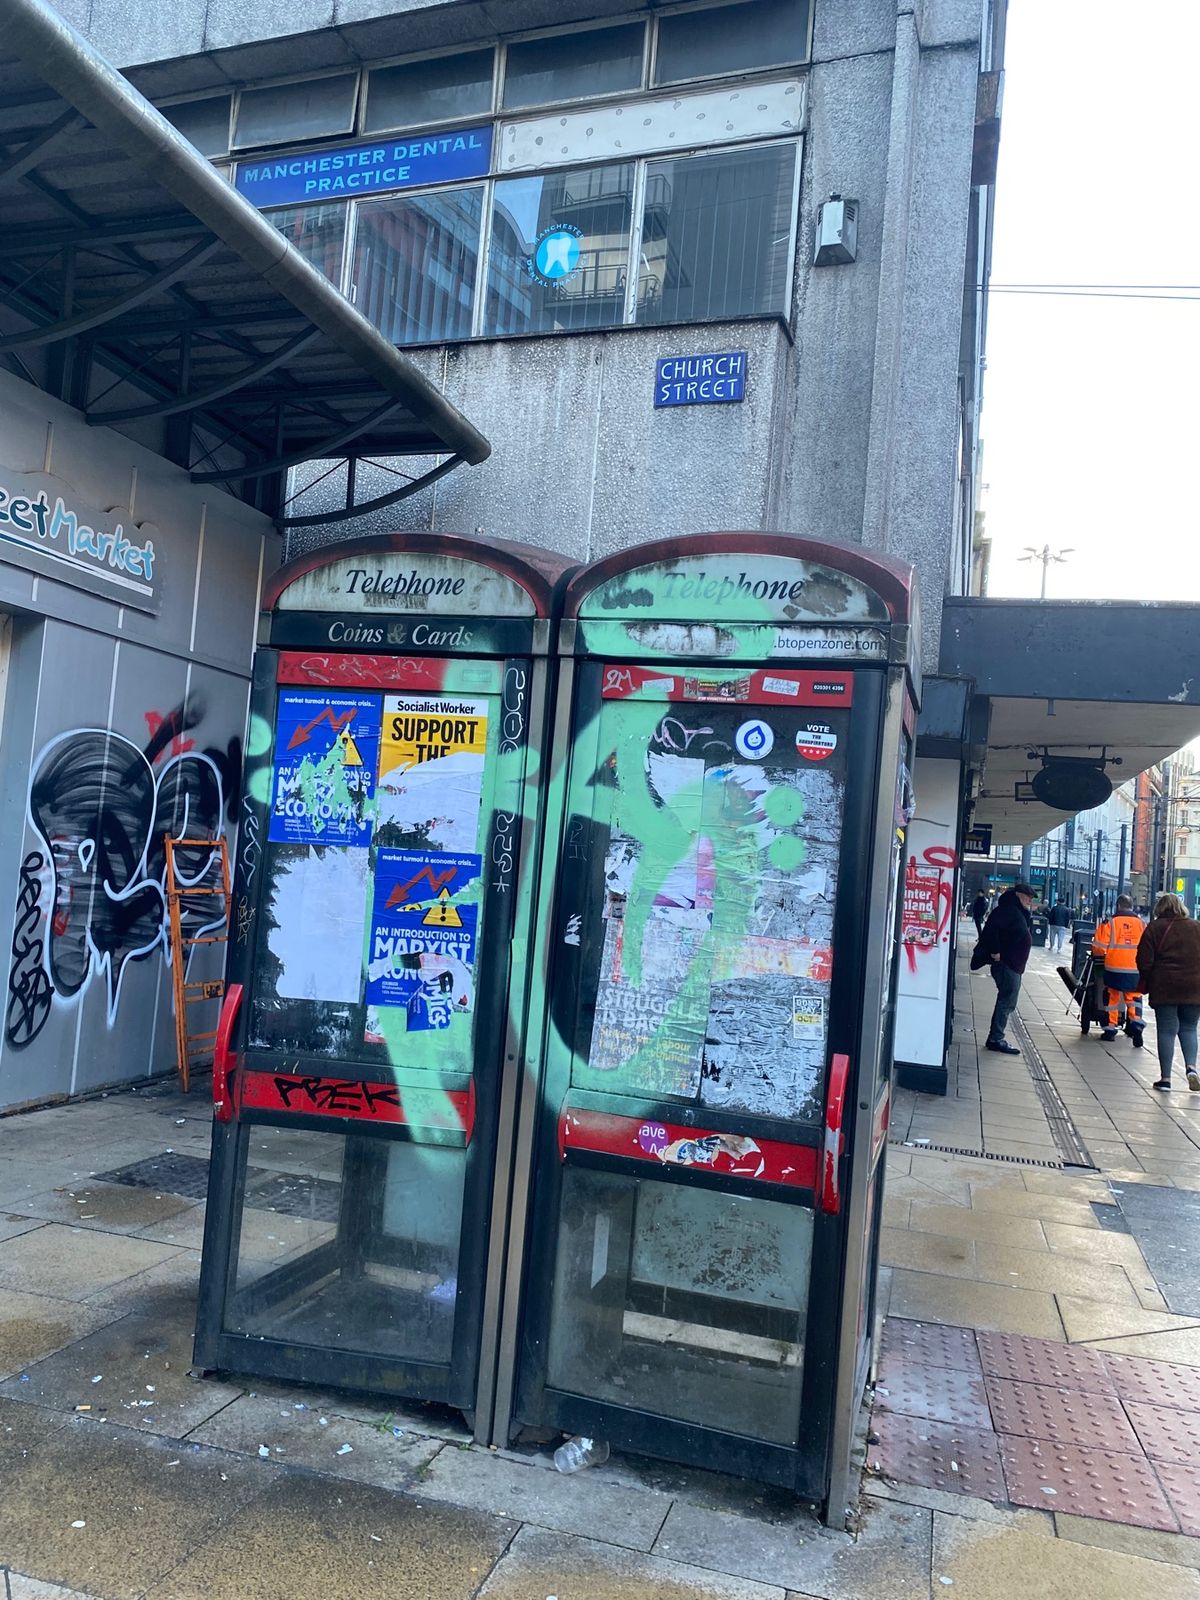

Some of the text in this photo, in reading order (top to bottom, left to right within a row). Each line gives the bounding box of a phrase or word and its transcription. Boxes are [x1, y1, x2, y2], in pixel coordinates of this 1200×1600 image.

[245, 134, 482, 184] MANCHESTER DENTAL
[304, 165, 411, 194] PRACTICE
[661, 356, 742, 380] CHURCH
[661, 378, 739, 402] STREET
[50, 497, 156, 581] Market
[346, 569, 466, 600] Telephone
[661, 572, 804, 605] Telephone
[328, 621, 384, 643] Coins
[411, 624, 474, 647] Cards
[284, 696, 304, 704] market
[304, 697, 325, 705] turmoil
[330, 699, 357, 707] economic
[397, 700, 476, 715] Socialist Worker
[391, 717, 479, 744] SUPPORT
[807, 724, 830, 733] VOTE
[278, 767, 291, 775] AN
[382, 854, 402, 862] market
[430, 858, 457, 866] economic
[375, 926, 471, 942] AN INTRODUCTION TO
[639, 1125, 666, 1139] ave
